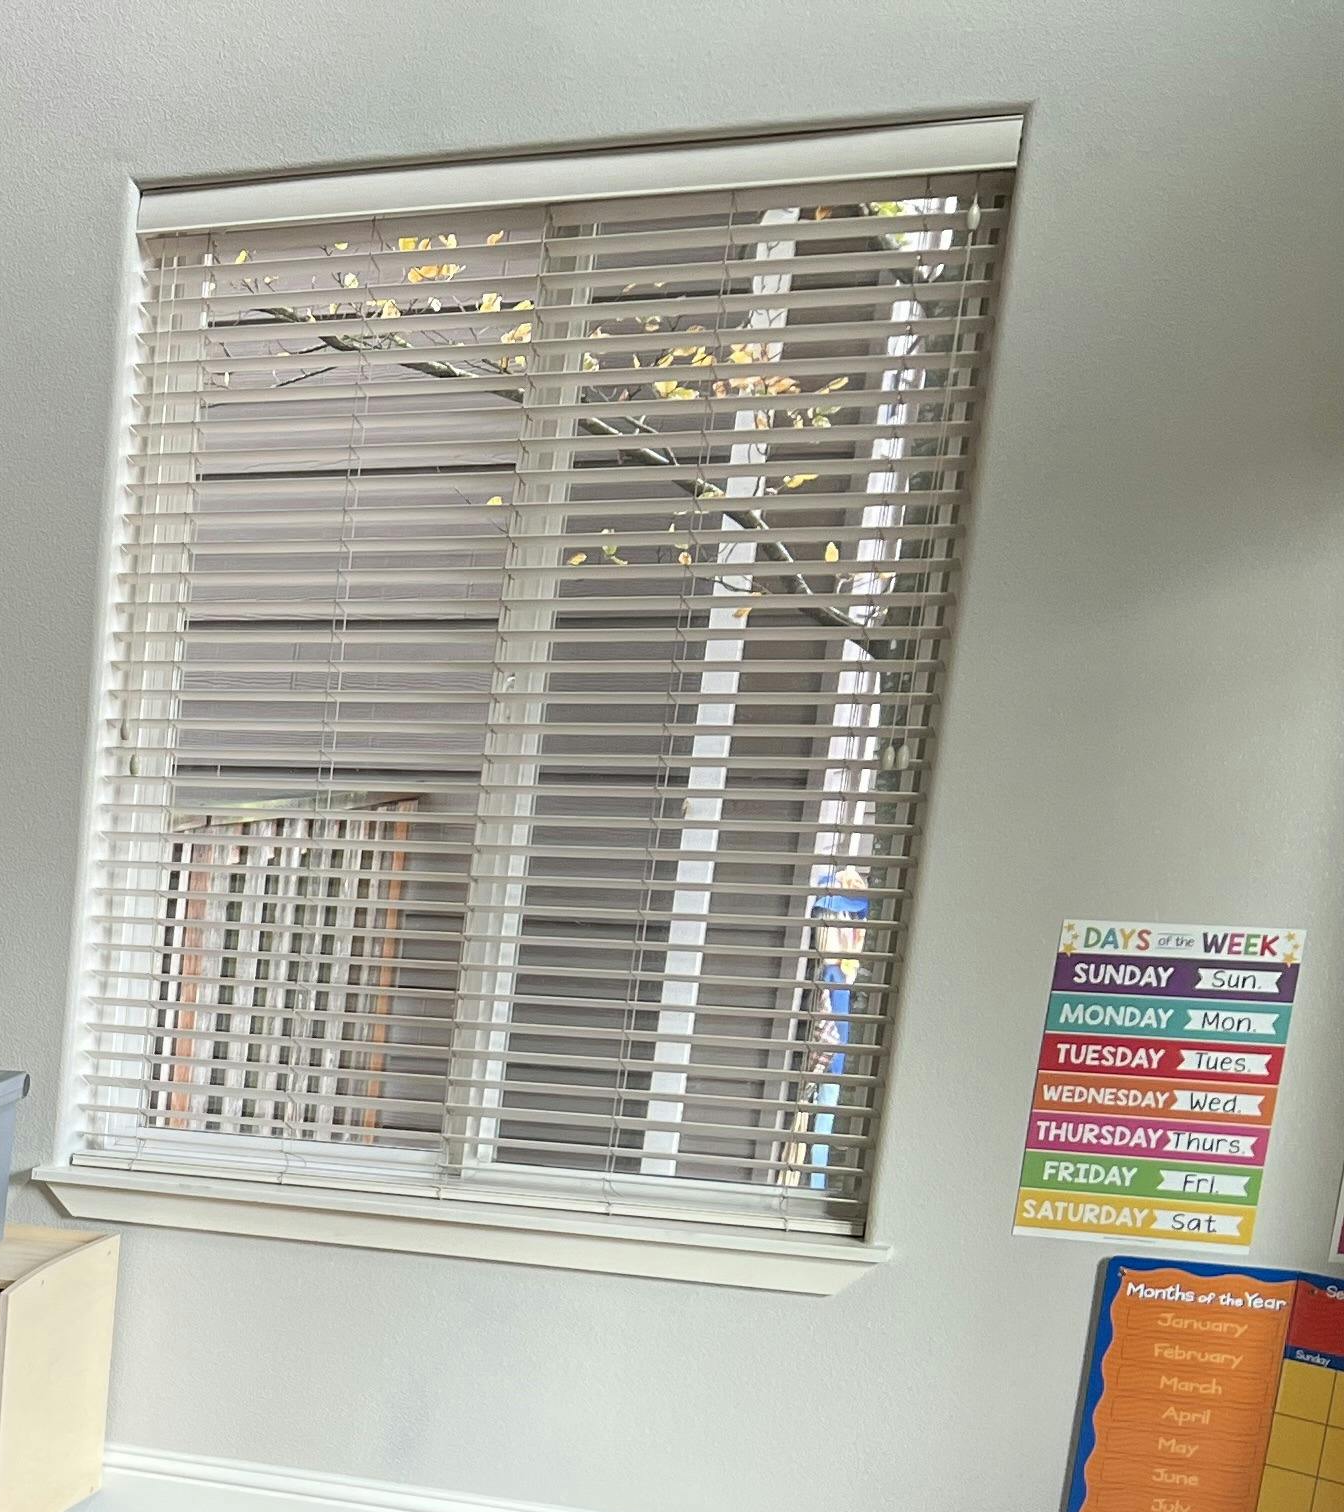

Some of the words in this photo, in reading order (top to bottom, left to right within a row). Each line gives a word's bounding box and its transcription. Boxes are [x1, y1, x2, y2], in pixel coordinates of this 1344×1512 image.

[1083, 927, 1152, 951] DAYS
[1157, 936, 1172, 947] of
[1175, 936, 1196, 947] the
[1202, 931, 1280, 957] WEEK
[1073, 961, 1175, 988] SUNDAY
[1211, 970, 1262, 990] Sun.
[1059, 1002, 1175, 1029] MONDAY
[1201, 1012, 1257, 1033] Mon.
[1057, 1043, 1166, 1070] TUESDAY
[1195, 1051, 1252, 1073] Tues.
[1042, 1083, 1170, 1109] WEDNESDAY
[1190, 1092, 1242, 1114] Wed.
[1036, 1120, 1164, 1150] THURSDAY
[1173, 1132, 1246, 1155] Thurs.
[1043, 1160, 1138, 1188] FRIDAY
[1022, 1198, 1149, 1228] SATURDAY
[1126, 1282, 1196, 1303] Months
[1198, 1292, 1217, 1304] of
[1219, 1294, 1244, 1308] the
[1244, 1291, 1288, 1311] Year
[1157, 1312, 1248, 1337] January
[1154, 1343, 1244, 1369] February
[1295, 1349, 1331, 1368] Sunday
[1159, 1375, 1223, 1395] March
[1161, 1406, 1211, 1426] April
[1158, 1437, 1199, 1457] May
[1152, 1468, 1200, 1486] June
